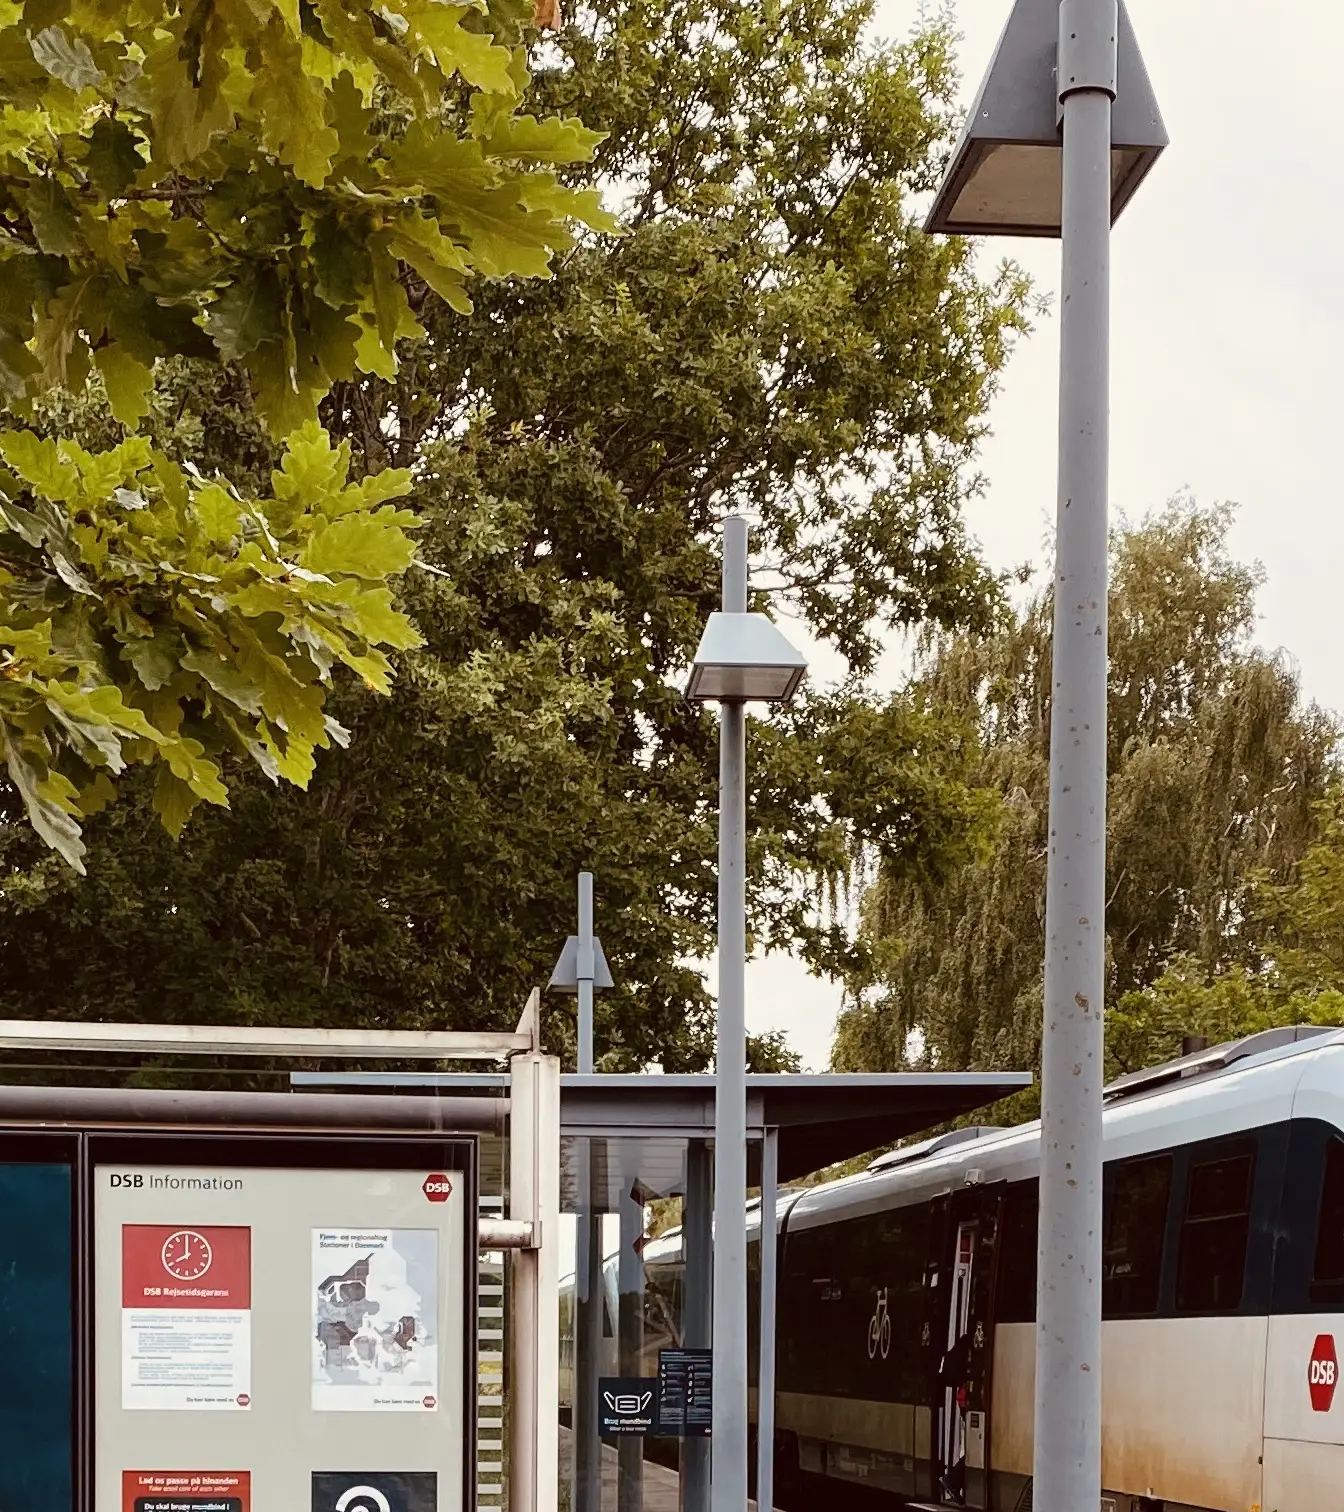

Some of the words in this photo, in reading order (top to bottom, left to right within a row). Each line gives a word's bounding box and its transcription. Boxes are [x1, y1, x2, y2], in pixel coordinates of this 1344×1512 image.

[110, 1174, 144, 1188] DSB
[149, 1175, 243, 1190] Information
[425, 1182, 450, 1193] DSB
[143, 1287, 161, 1296] DSB
[1311, 1360, 1335, 1385] DSB
[190, 1477, 201, 1486] på
